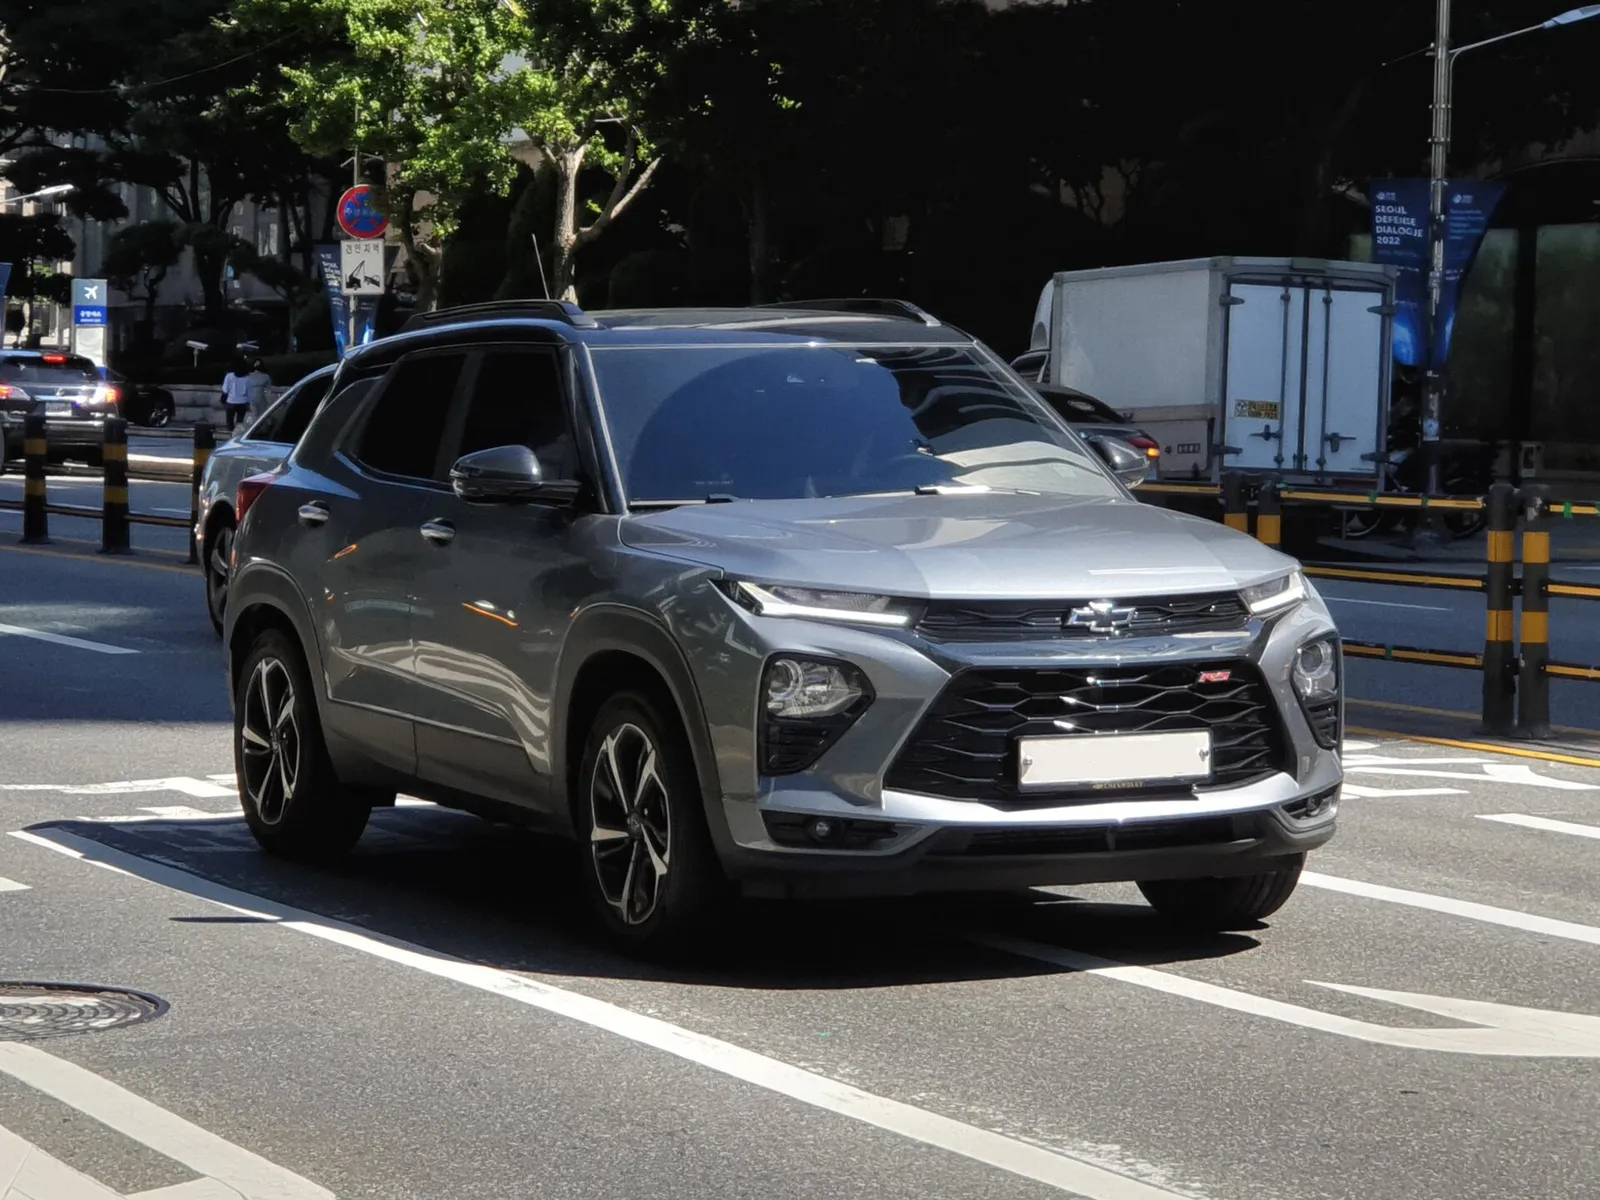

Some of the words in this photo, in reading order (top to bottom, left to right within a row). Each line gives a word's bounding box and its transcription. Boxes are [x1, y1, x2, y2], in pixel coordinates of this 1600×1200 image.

[1375, 205, 1408, 214] SEOUL
[1375, 215, 1417, 226] DEFENSE
[1375, 226, 1424, 238] DIALOGUE
[1376, 236, 1401, 245] 2022
